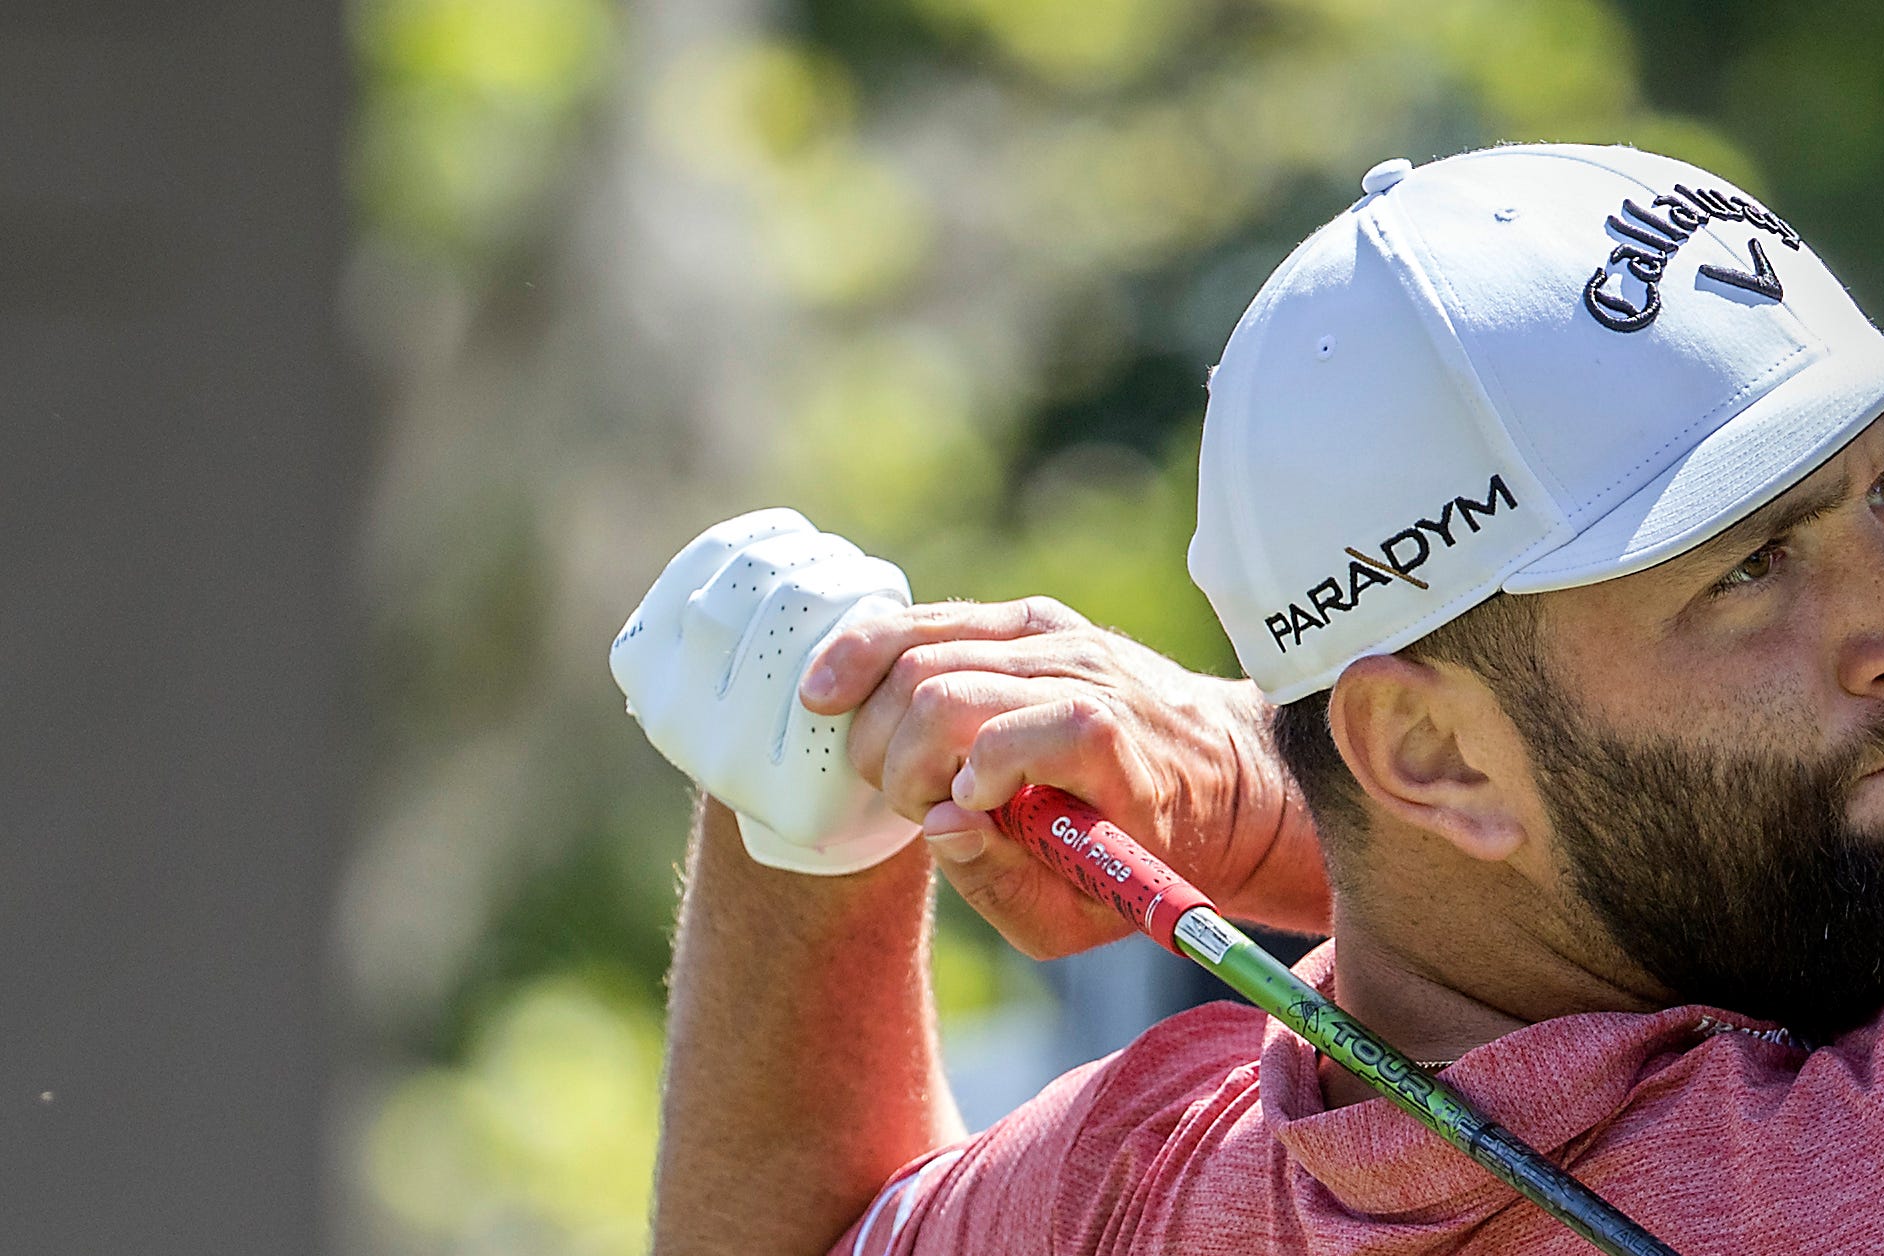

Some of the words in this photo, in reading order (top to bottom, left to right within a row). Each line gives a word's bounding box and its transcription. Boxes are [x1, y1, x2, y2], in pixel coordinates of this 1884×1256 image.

[1583, 184, 1800, 333] Callaway
[1265, 473, 1518, 654] PARADYM
[1051, 816, 1092, 852] Golf
[1331, 1020, 1435, 1110] TOUR
